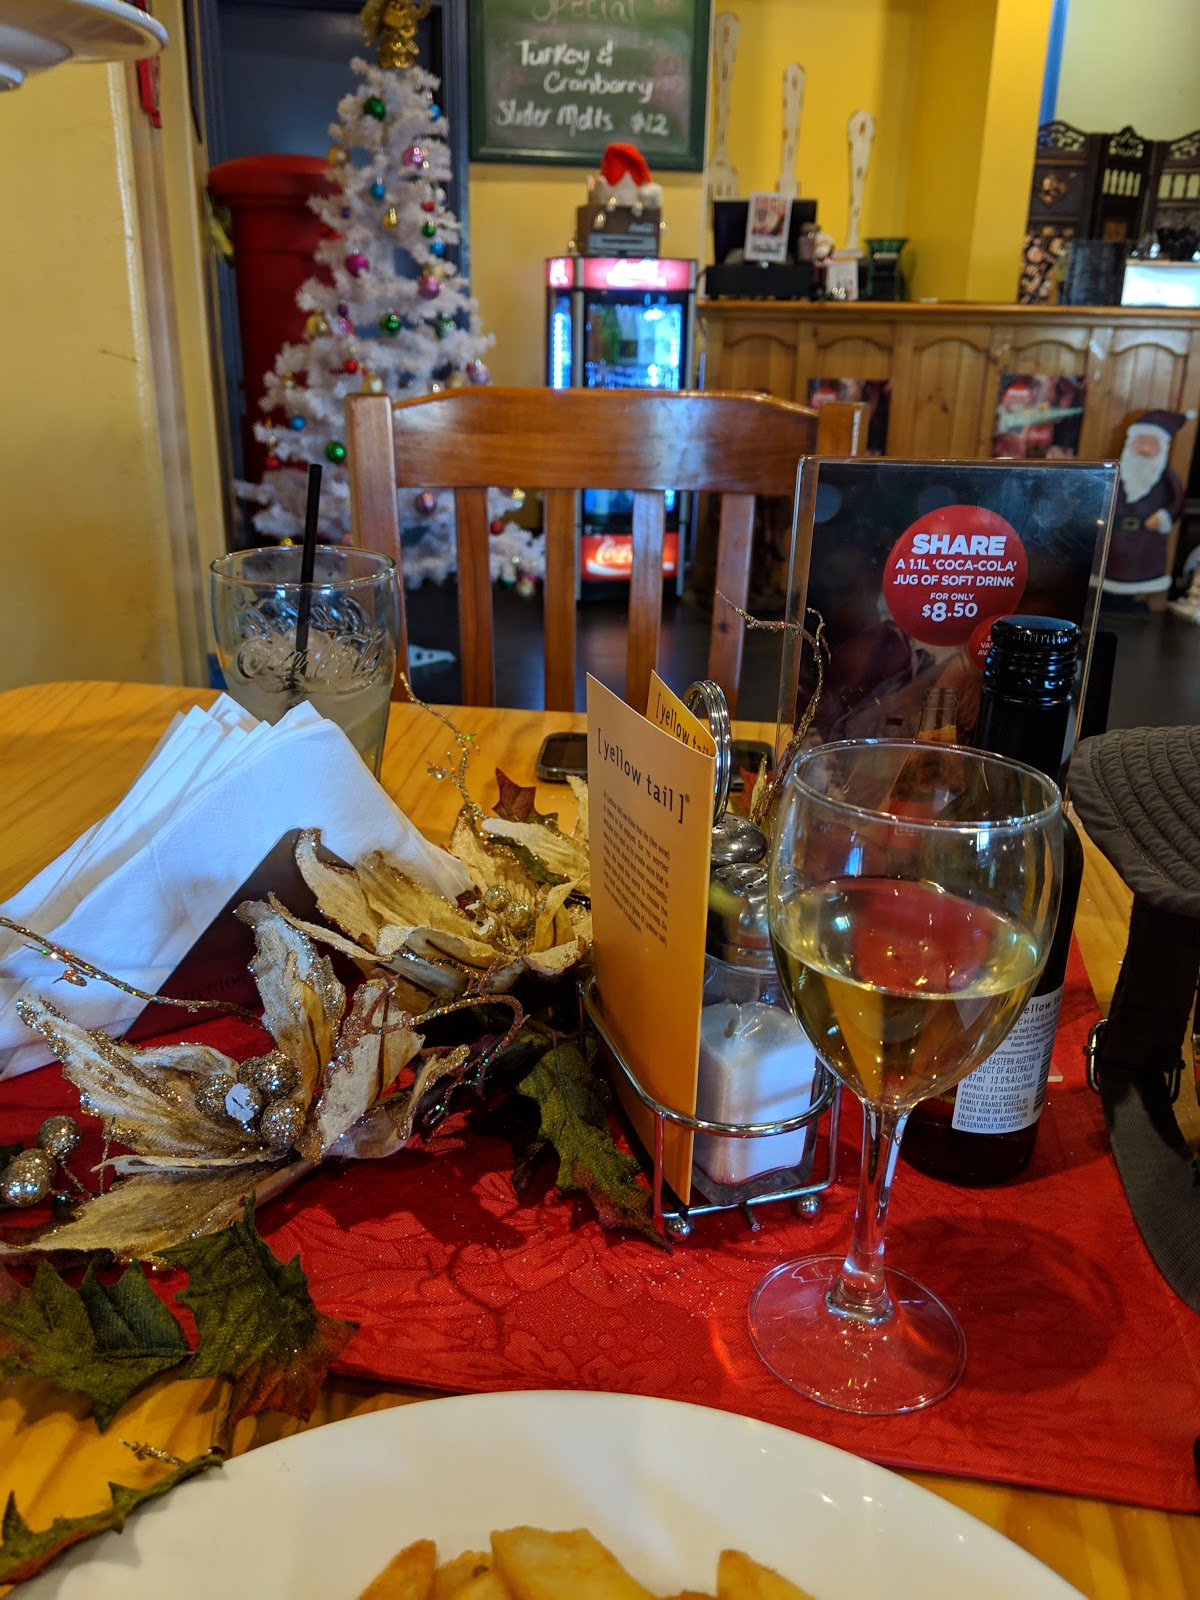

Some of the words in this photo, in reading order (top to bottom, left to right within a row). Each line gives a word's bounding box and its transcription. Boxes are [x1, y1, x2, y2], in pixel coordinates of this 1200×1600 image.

[515, 39, 590, 75] Turkey
[543, 70, 655, 104] Cranberry
[911, 533, 1007, 556] SHARE
[895, 558, 906, 570] A
[909, 558, 930, 571] 1.1L
[893, 574, 919, 585] JUG
[920, 575, 939, 586] OF
[941, 575, 974, 586] SOFT
[975, 575, 1016, 587] DRINK
[930, 592, 949, 600] FOR
[950, 592, 975, 601] ONLY
[922, 602, 978, 622] $8.50
[1023, 1001, 1052, 1015] ellow
[988, 1056, 1015, 1066] EASTERN
[1015, 1052, 1041, 1064] AUSTRALIA
[975, 1065, 995, 1074] DUCT
[996, 1066, 1005, 1075] OF
[1005, 1063, 1035, 1075] AUSTRALIA
[962, 1083, 984, 1092] APPROX
[994, 1084, 1020, 1093] STANDARD
[961, 1090, 990, 1101] PRODUCED
[998, 1093, 1020, 1101] CASELLA
[960, 1098, 980, 1107] FAMILY
[1003, 1104, 1028, 1114] AUSTRALIA
[957, 1112, 976, 1121] ENJOY
[956, 1119, 994, 1130] PRESERVATIVE
